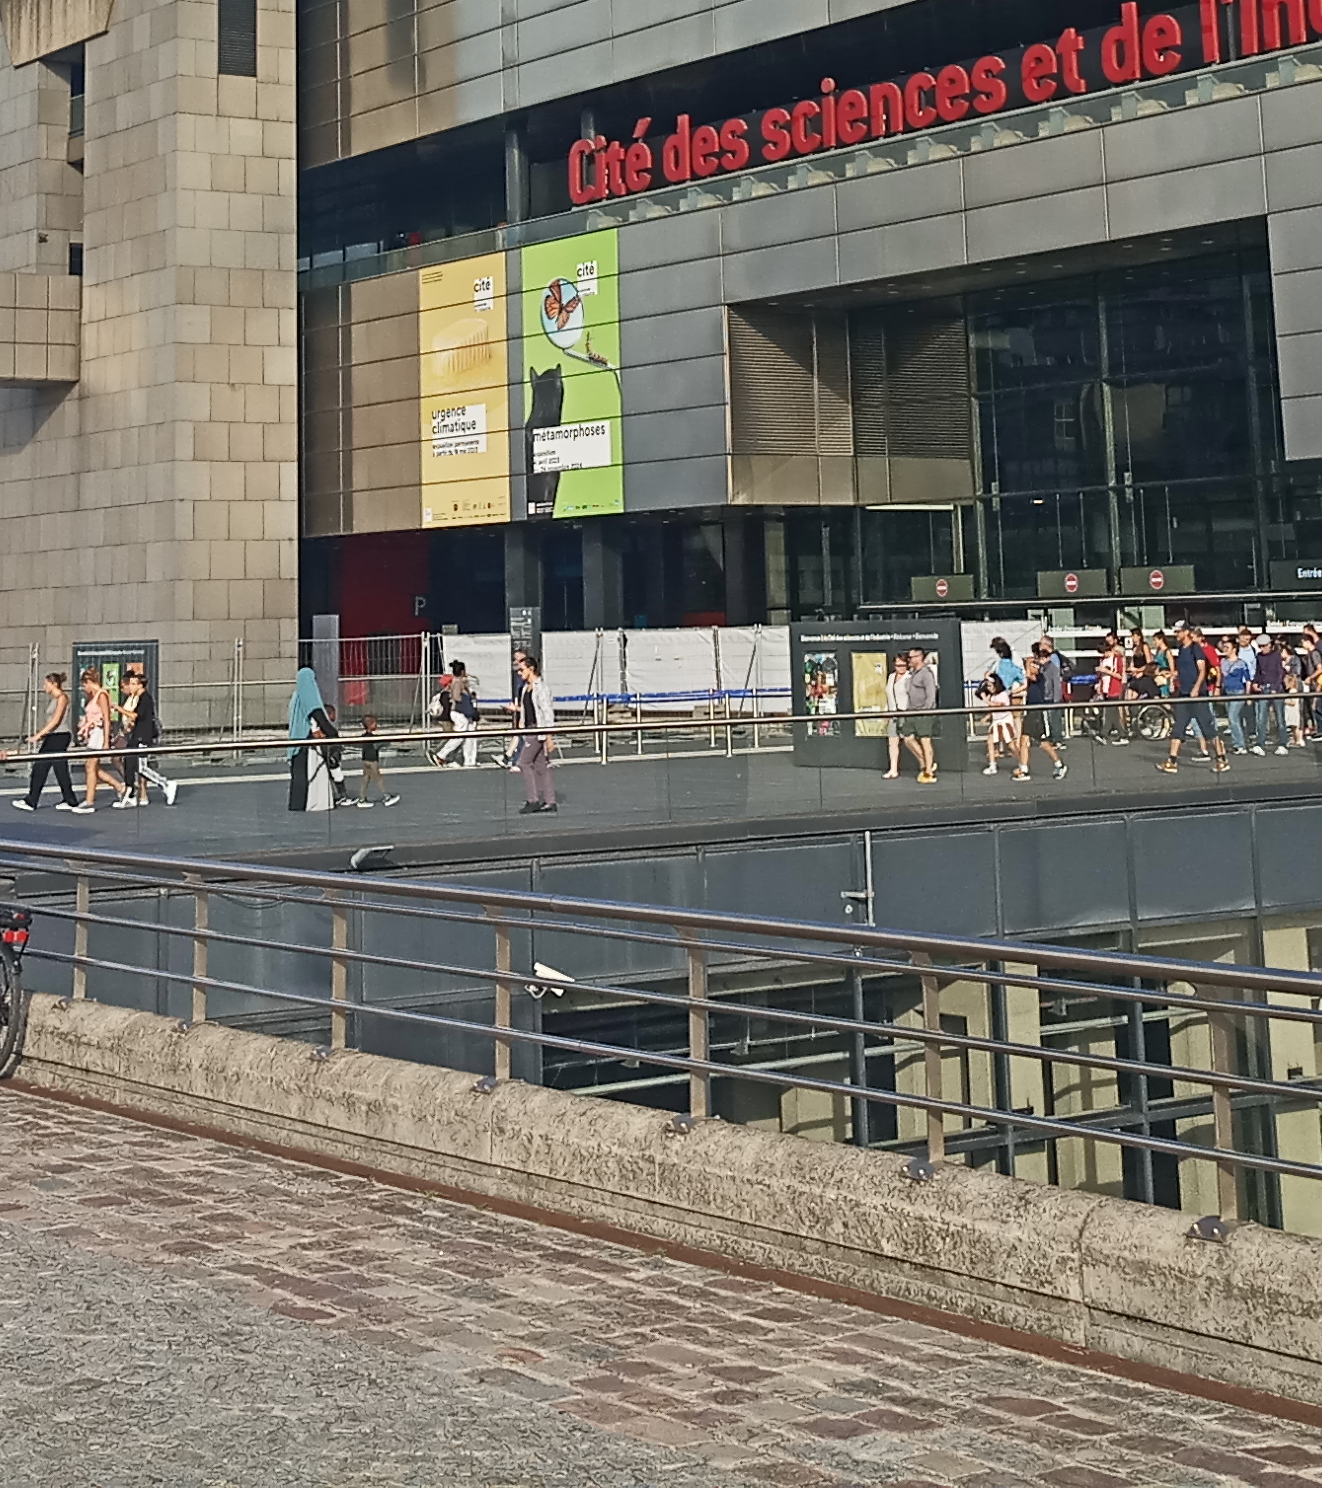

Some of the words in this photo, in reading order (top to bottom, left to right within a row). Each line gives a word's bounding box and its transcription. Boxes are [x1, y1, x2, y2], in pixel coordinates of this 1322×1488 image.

[568, 116, 652, 204] Cité
[663, 114, 749, 181] des
[761, 77, 1008, 161] sciences
[1021, 28, 1086, 103] et
[1101, 2, 1183, 83] de
[432, 405, 466, 422] urgence
[432, 419, 477, 434] climatique
